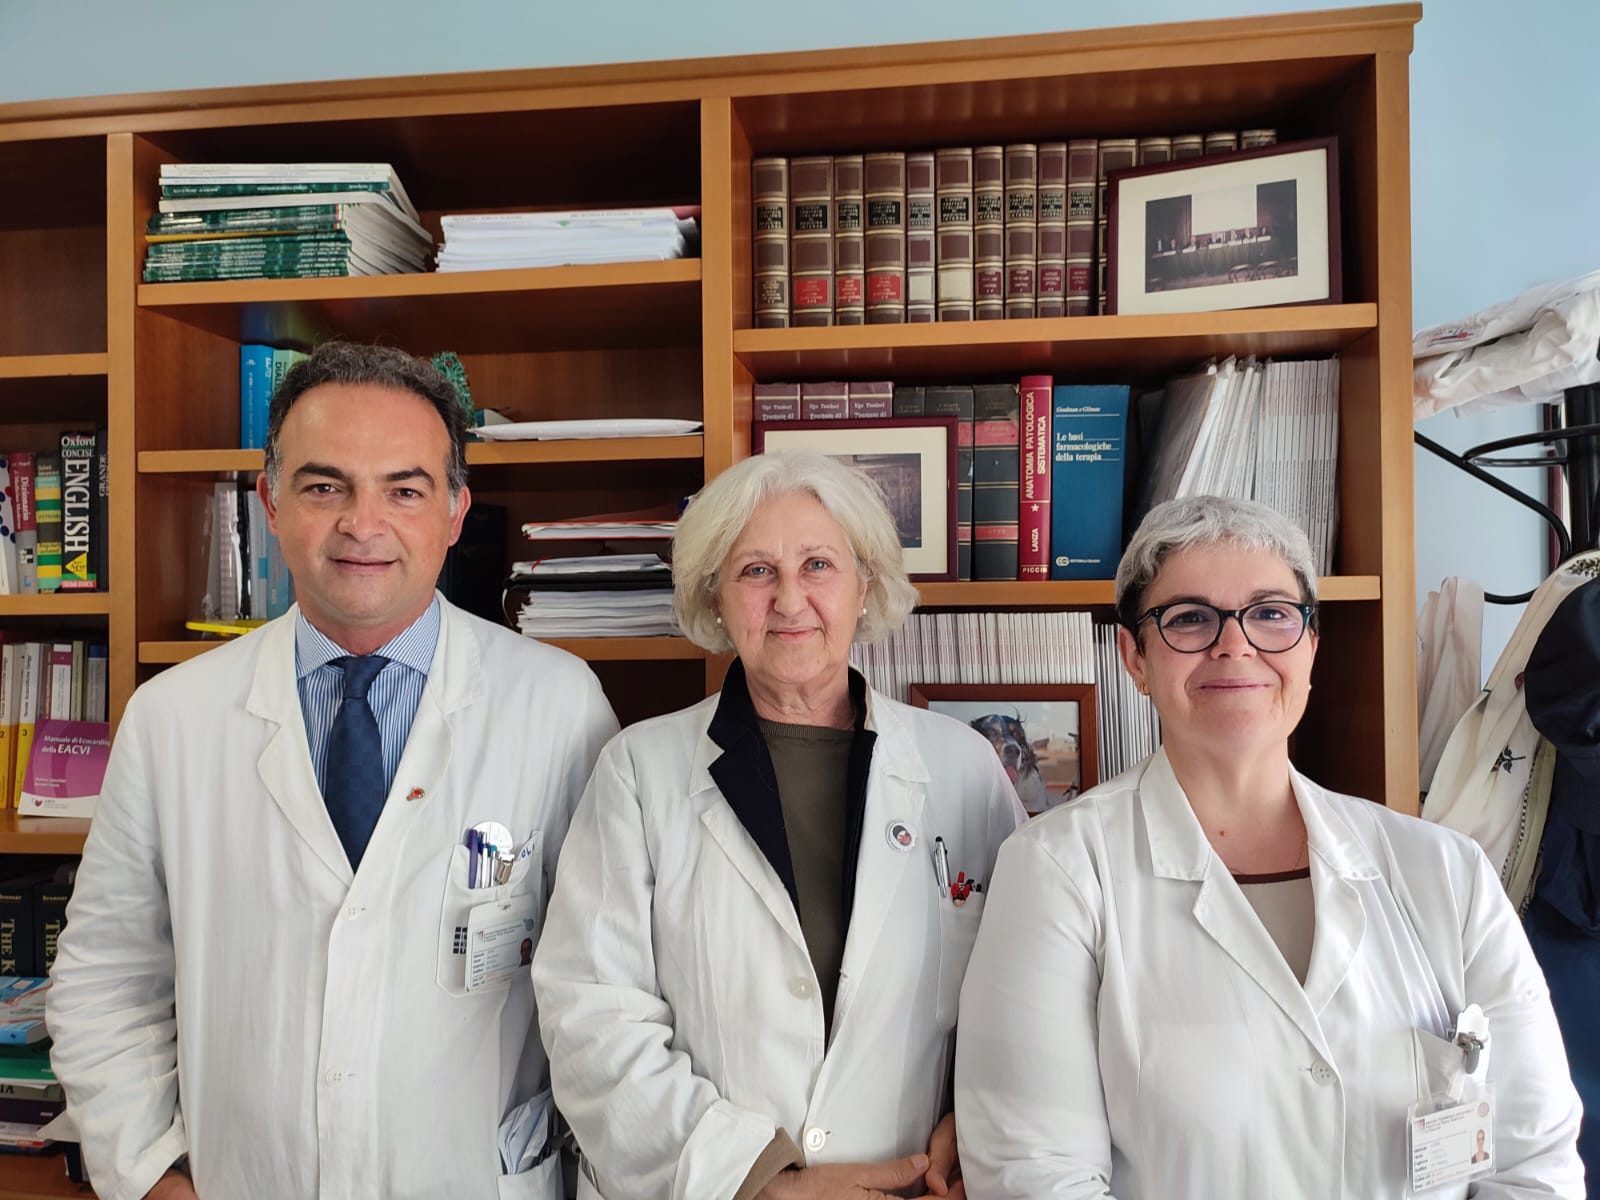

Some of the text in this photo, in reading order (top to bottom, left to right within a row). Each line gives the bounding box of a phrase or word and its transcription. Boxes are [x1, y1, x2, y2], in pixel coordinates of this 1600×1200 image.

[61, 435, 96, 447] Oxford
[1056, 432, 1084, 441] Le basi
[1025, 391, 1034, 499] ANATOMIA PATOLOGICA
[1037, 415, 1046, 475] SISTEMATICA
[1056, 442, 1112, 452] farmacologiche
[61, 449, 94, 458] CONCISE
[1056, 452, 1102, 462] della terapia
[20, 476, 30, 521] Dizionario
[64, 458, 90, 553] ENGLISH
[1031, 527, 1039, 552] LANZA
[22, 729, 28, 737] 3
[44, 735, 70, 743] Manuale
[57, 743, 91, 755] EACVI
[1, 918, 15, 955] THE
[45, 919, 60, 957] THE
